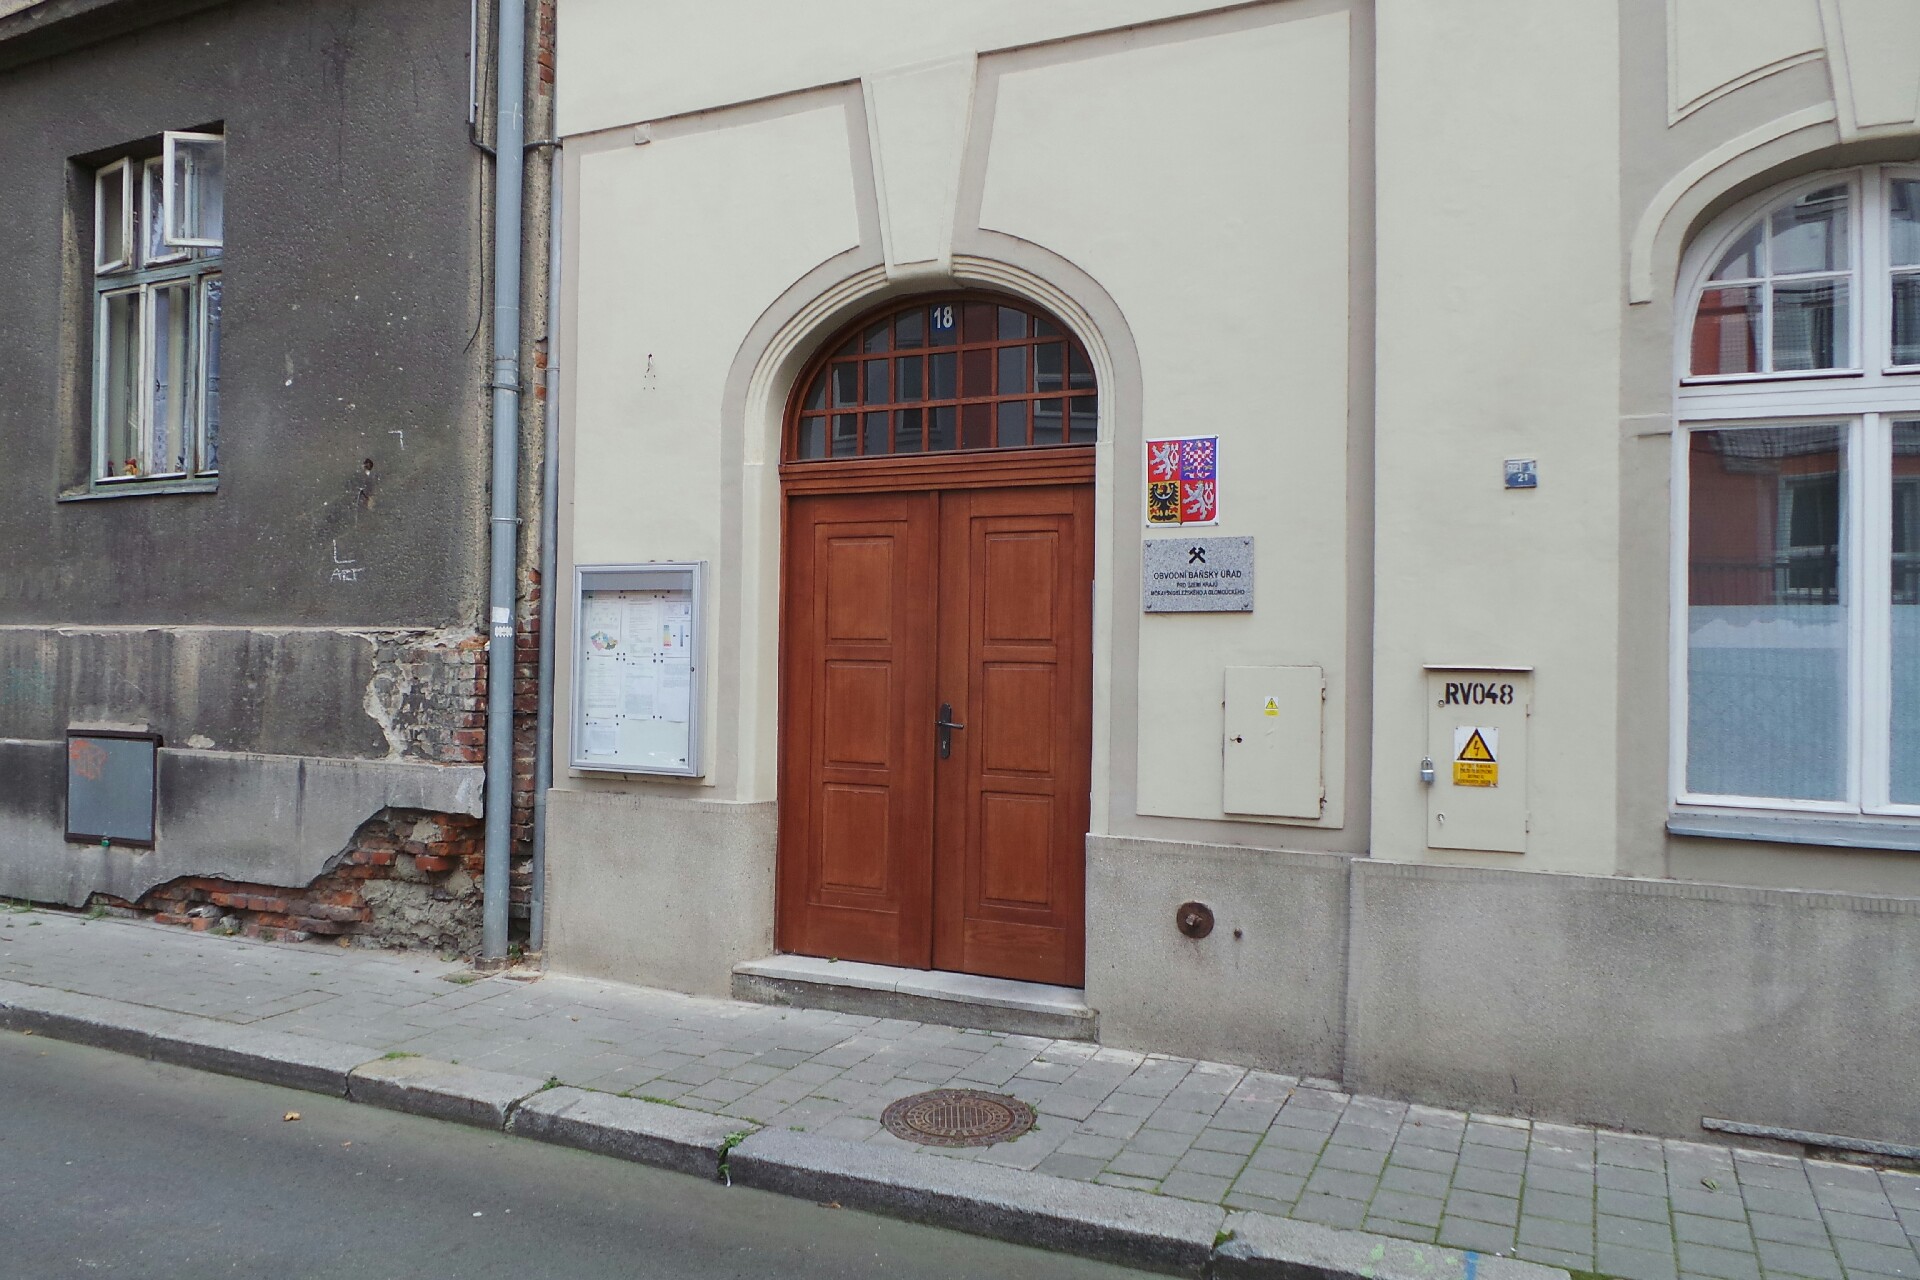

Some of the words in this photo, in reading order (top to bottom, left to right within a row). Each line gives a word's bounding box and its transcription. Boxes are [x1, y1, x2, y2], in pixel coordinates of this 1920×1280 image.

[933, 306, 953, 328] 18
[1517, 473, 1529, 482] 21
[1153, 569, 1187, 580] OBVODNÍ
[1445, 682, 1514, 705] RV048
